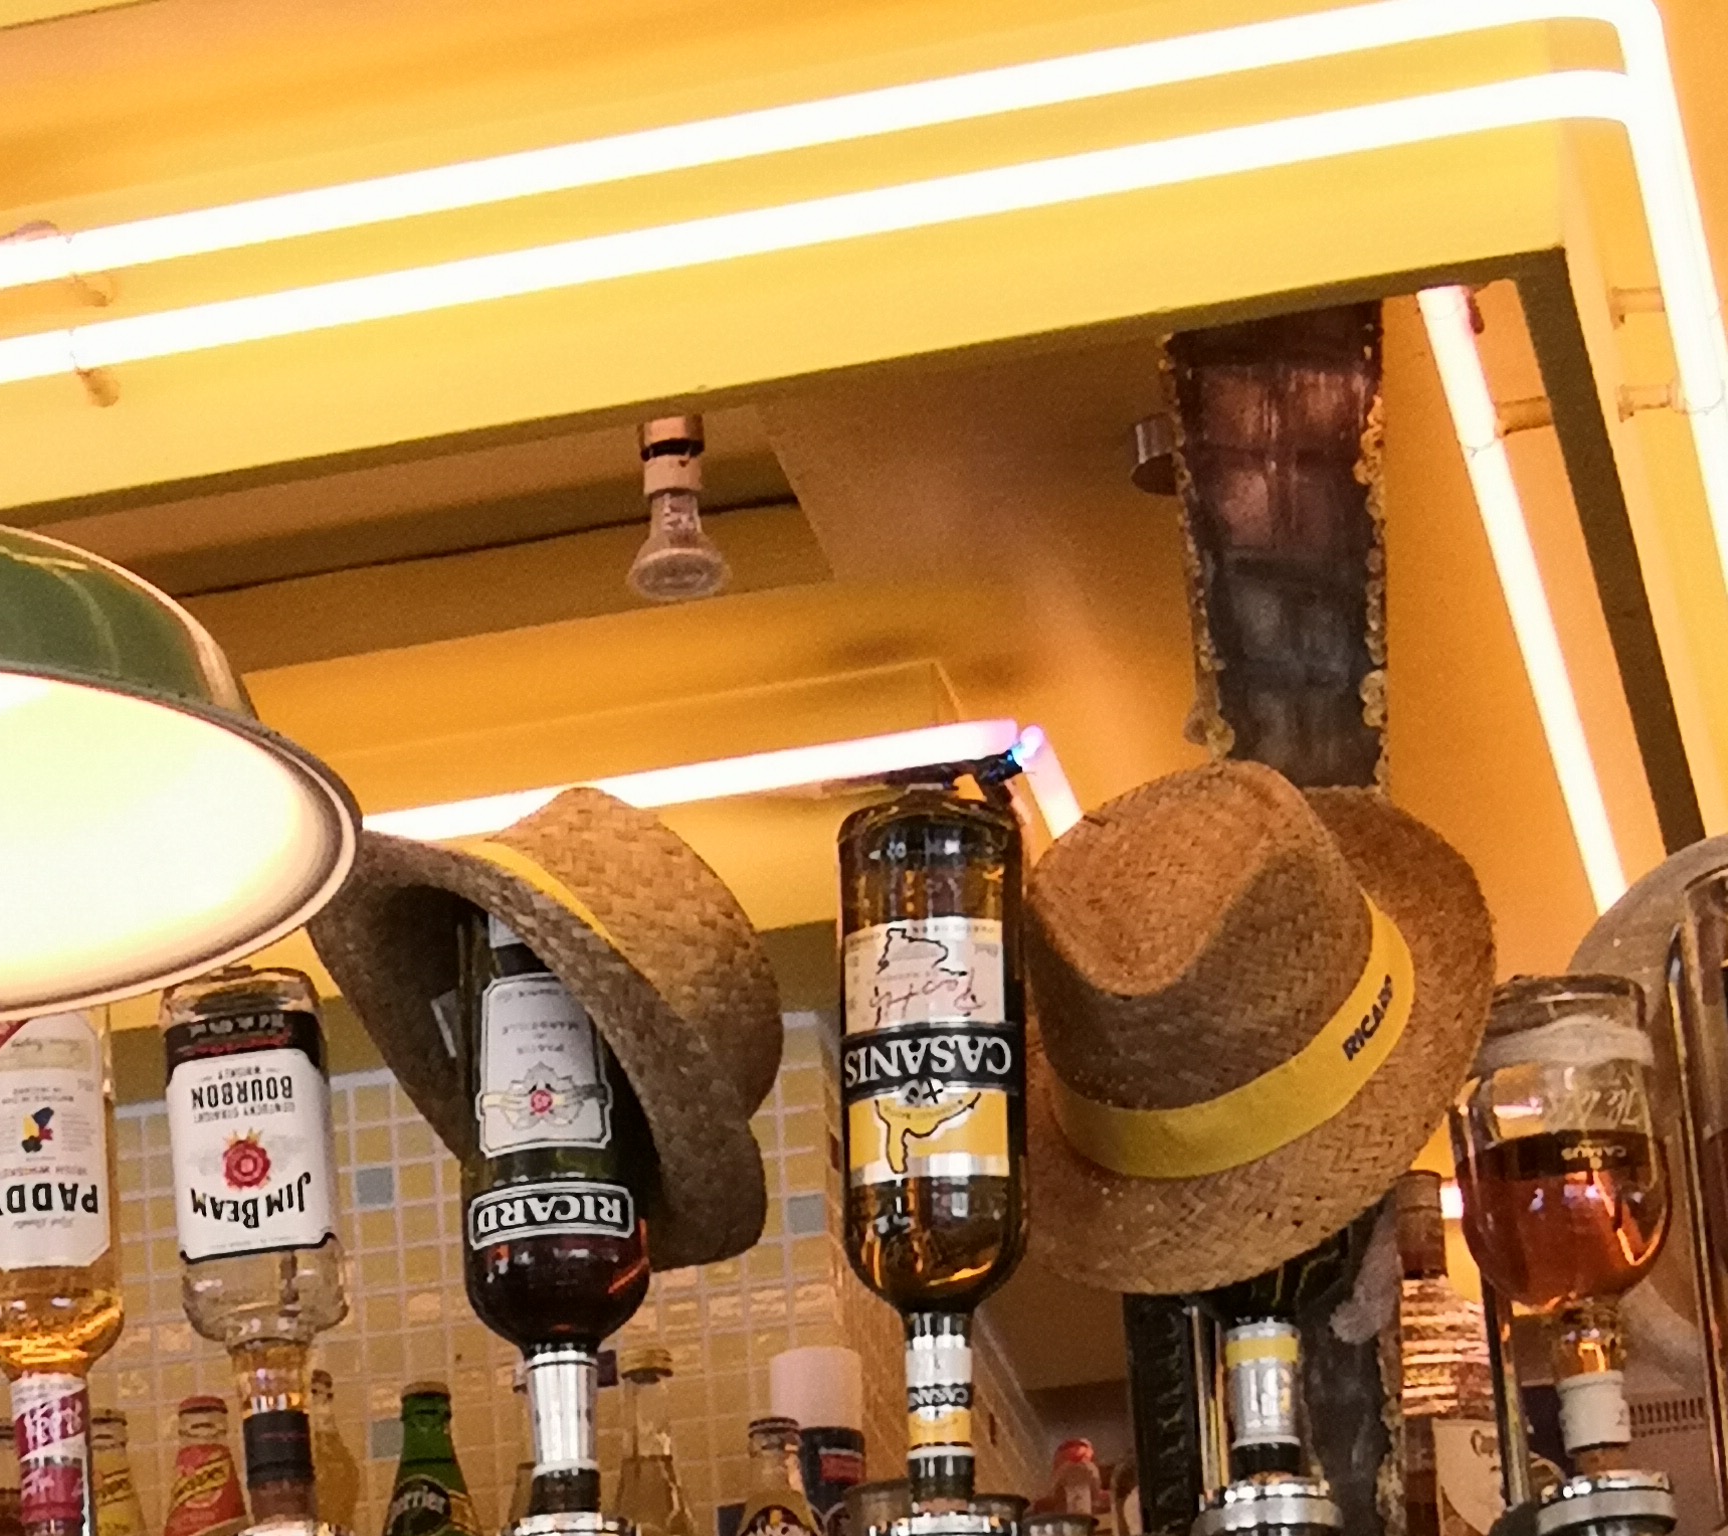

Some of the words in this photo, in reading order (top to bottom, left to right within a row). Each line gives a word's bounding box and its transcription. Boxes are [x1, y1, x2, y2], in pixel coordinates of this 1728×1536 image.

[844, 1034, 1012, 1089] CASANIS
[189, 1075, 293, 1110] BOURBON
[189, 1188, 260, 1230] BEAM
[265, 1171, 312, 1219] JIM
[475, 1195, 623, 1234] RICARD
